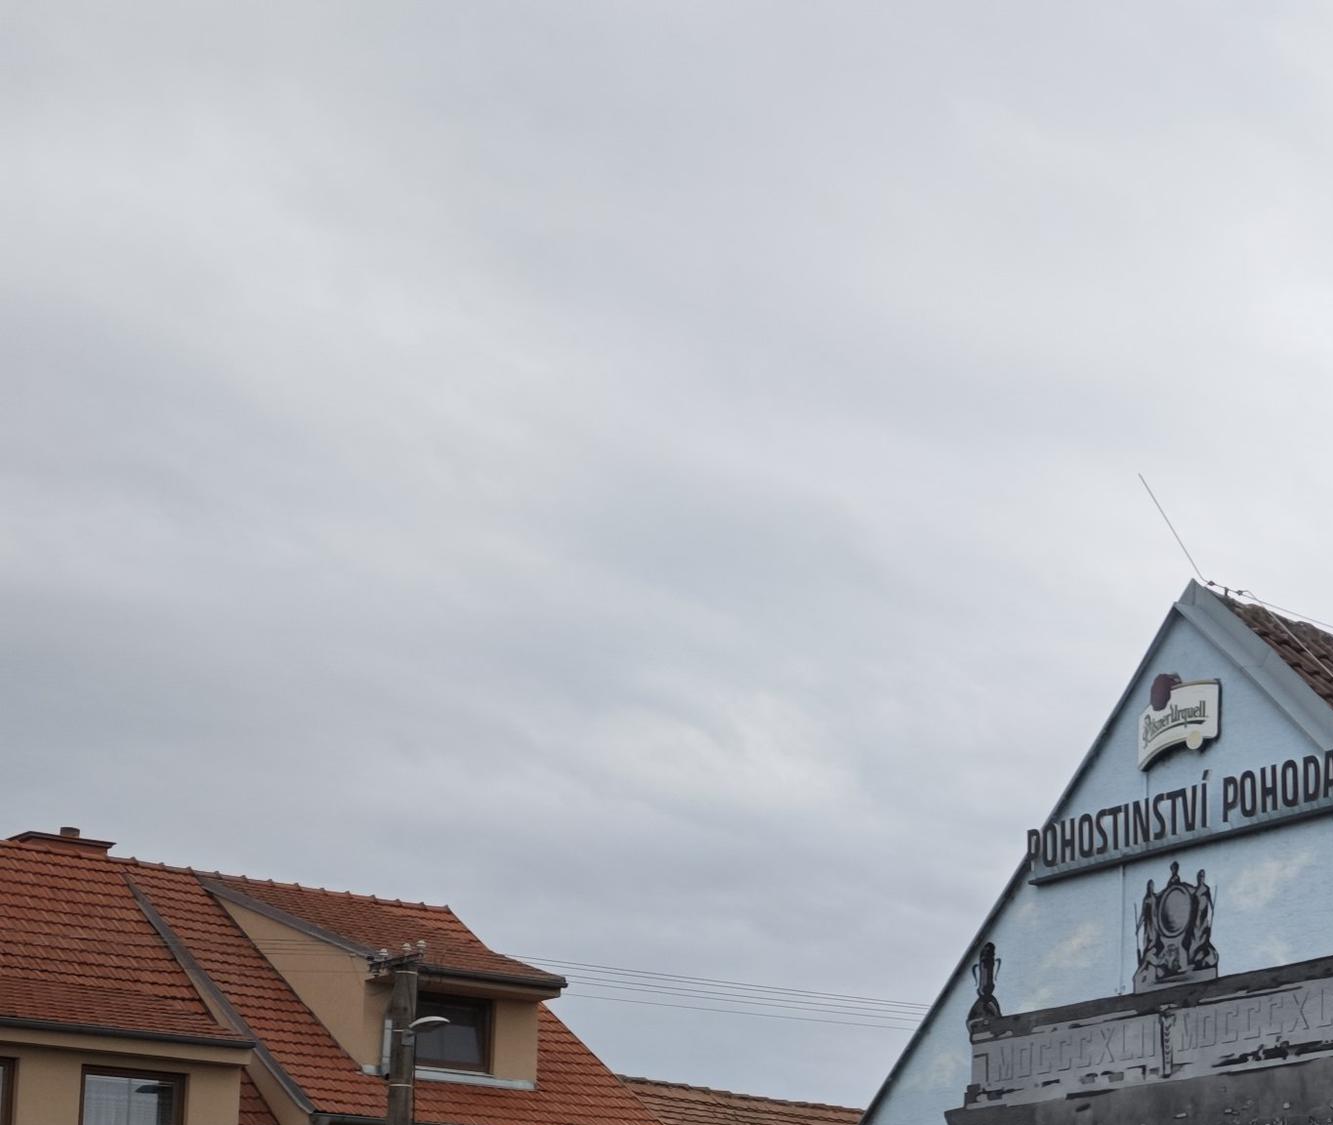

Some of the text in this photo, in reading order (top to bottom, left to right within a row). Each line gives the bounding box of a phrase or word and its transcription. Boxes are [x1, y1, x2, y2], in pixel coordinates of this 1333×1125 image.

[1143, 700, 1206, 749] Pilsner Urquell
[1027, 769, 1212, 871] POHOSTINSTVÍ
